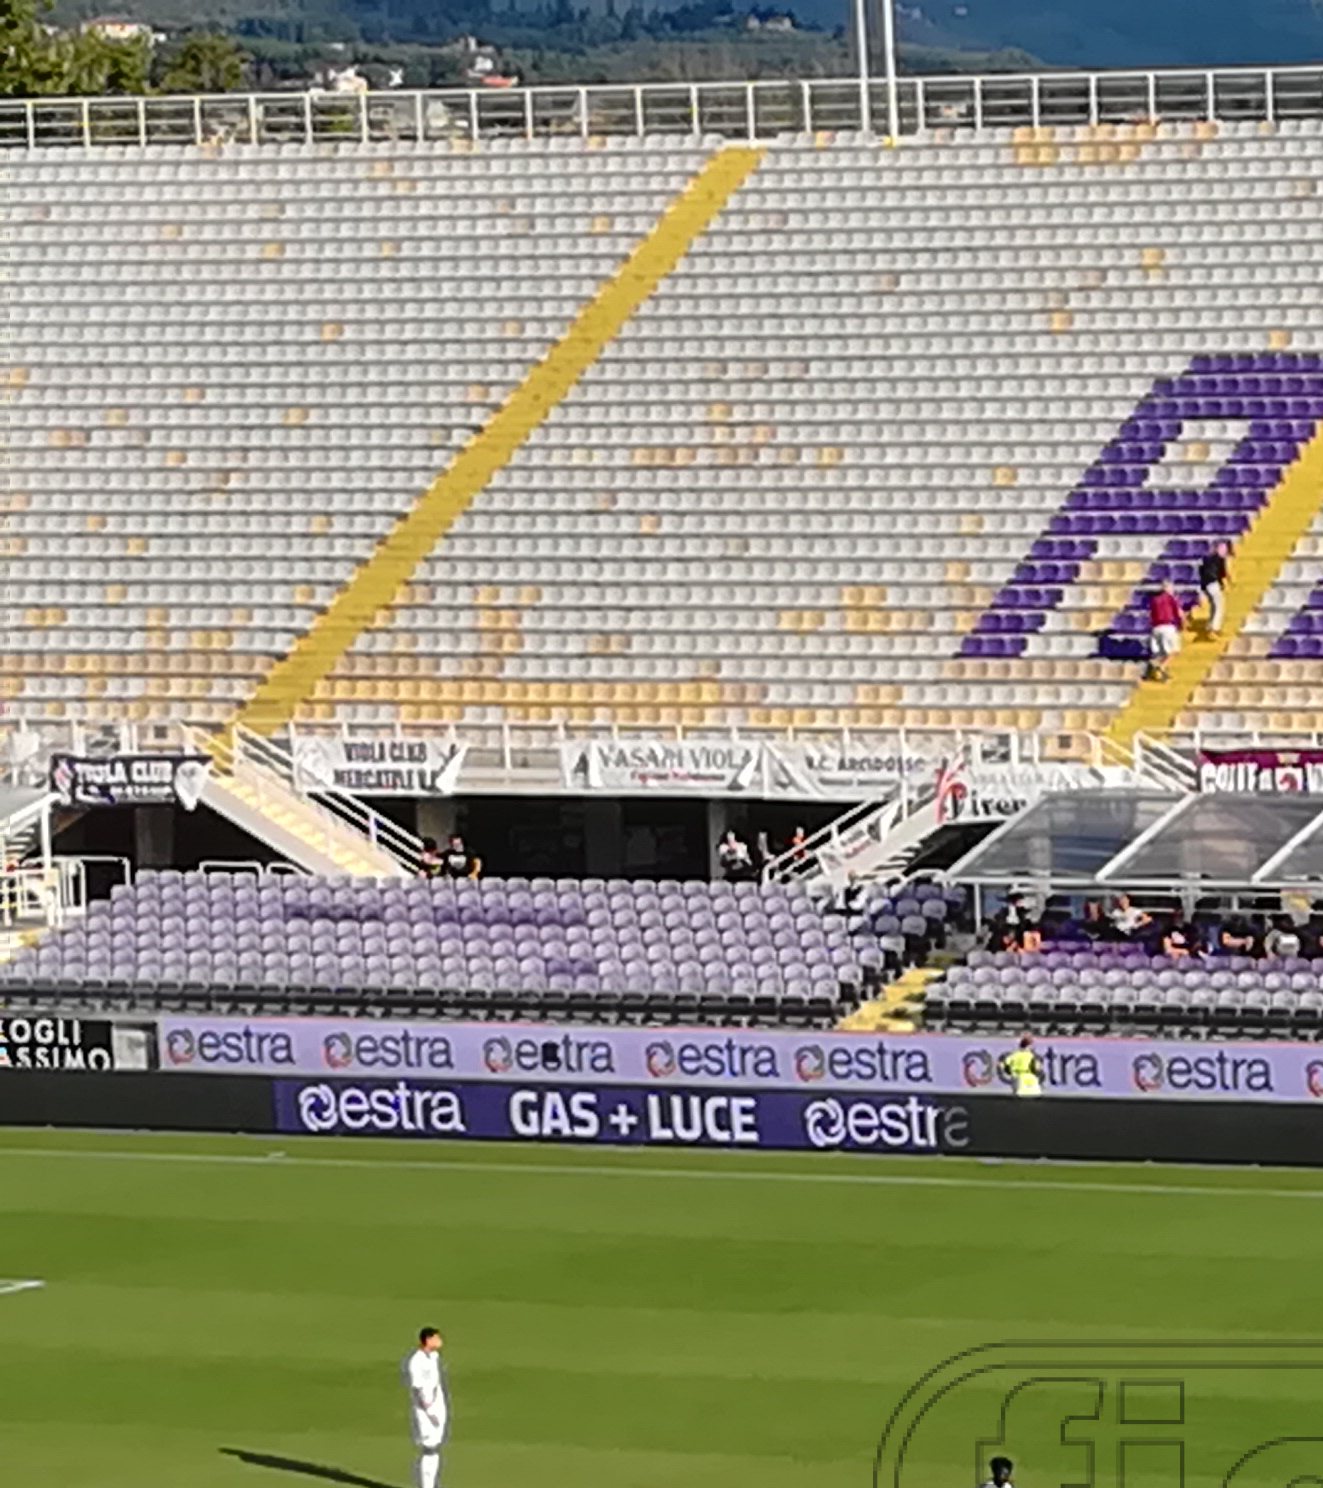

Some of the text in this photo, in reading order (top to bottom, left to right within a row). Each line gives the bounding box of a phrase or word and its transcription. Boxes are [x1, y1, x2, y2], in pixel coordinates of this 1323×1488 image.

[197, 1024, 297, 1066] estra
[356, 1028, 455, 1069] estra
[677, 1037, 779, 1079] estra
[828, 1040, 933, 1083] estra
[1166, 1048, 1273, 1092] estra
[338, 1081, 466, 1134] estra
[509, 1089, 600, 1138] GAS
[647, 1093, 760, 1145] LUCE
